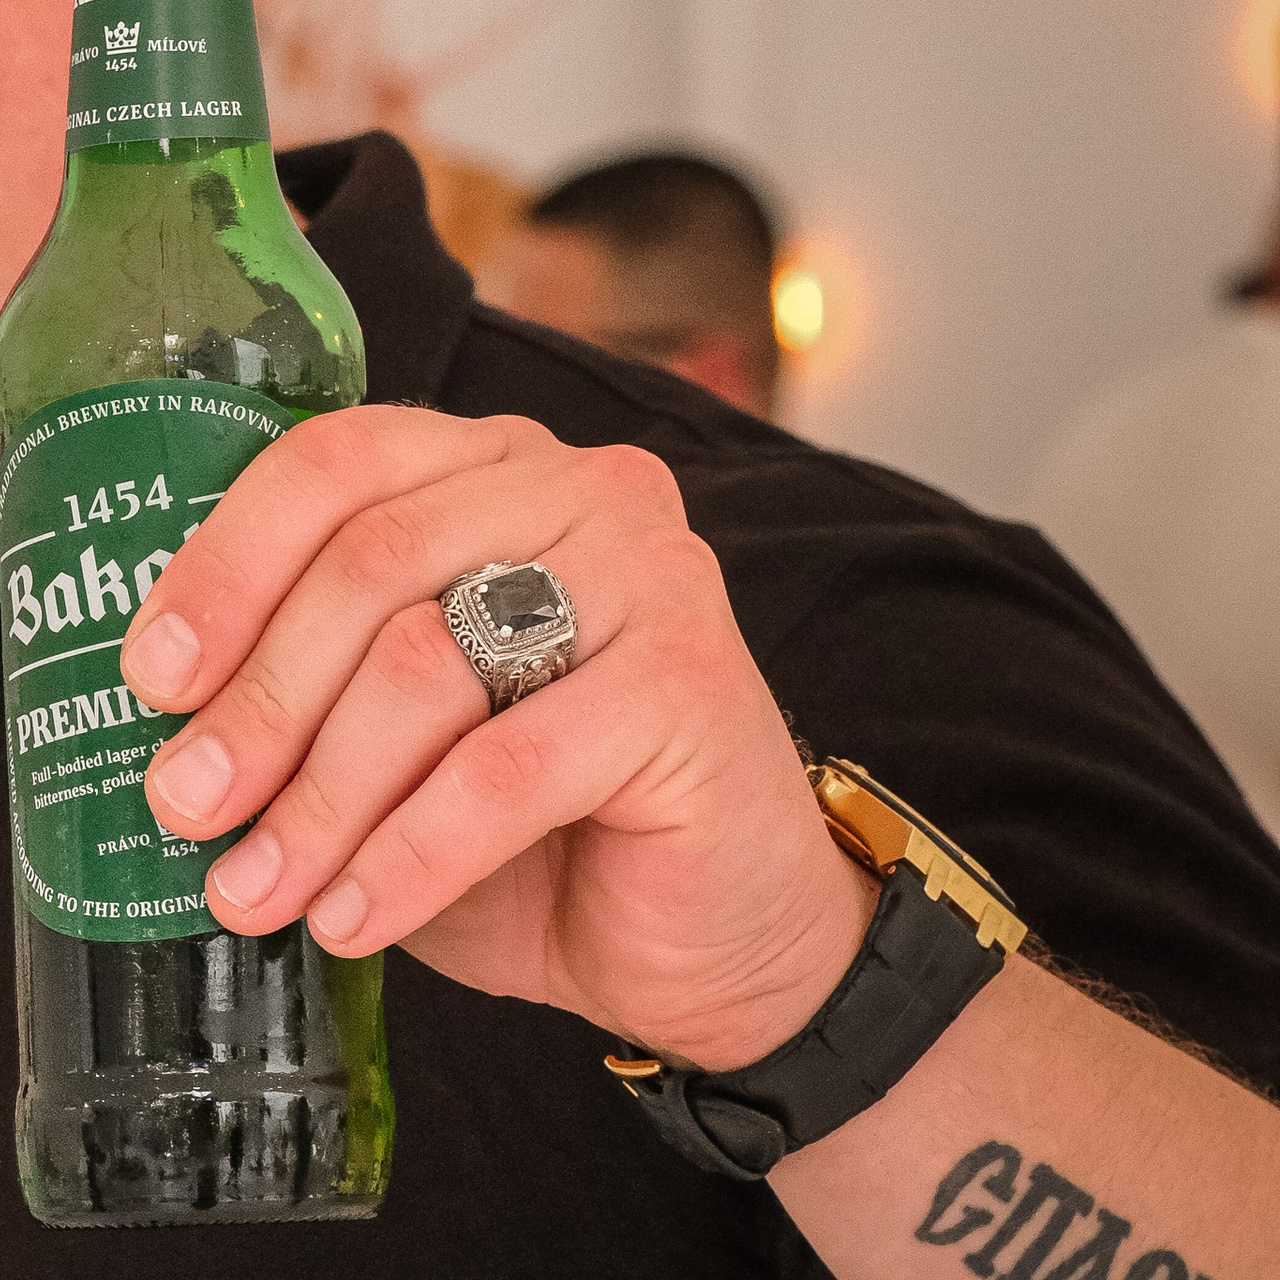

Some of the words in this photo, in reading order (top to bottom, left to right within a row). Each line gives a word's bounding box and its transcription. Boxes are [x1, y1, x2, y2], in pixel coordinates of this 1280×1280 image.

[146, 36, 207, 54] MÍLOVÉ
[105, 56, 138, 72] 1454
[106, 101, 173, 123] CZECH
[180, 100, 243, 118] LAGER
[56, 395, 150, 433] BREWERY
[157, 395, 182, 411] IN
[189, 395, 287, 440] RAKOVNI
[63, 472, 174, 533] 1454
[30, 751, 104, 786] Full-bodied
[106, 745, 147, 765] lager
[33, 781, 99, 810] bitterness,
[101, 769, 147, 795] golde
[97, 833, 150, 856] PRÁVO
[161, 840, 199, 858] 1454
[13, 812, 54, 904] ACCORDING
[57, 892, 78, 913] TO
[82, 899, 121, 919] THE
